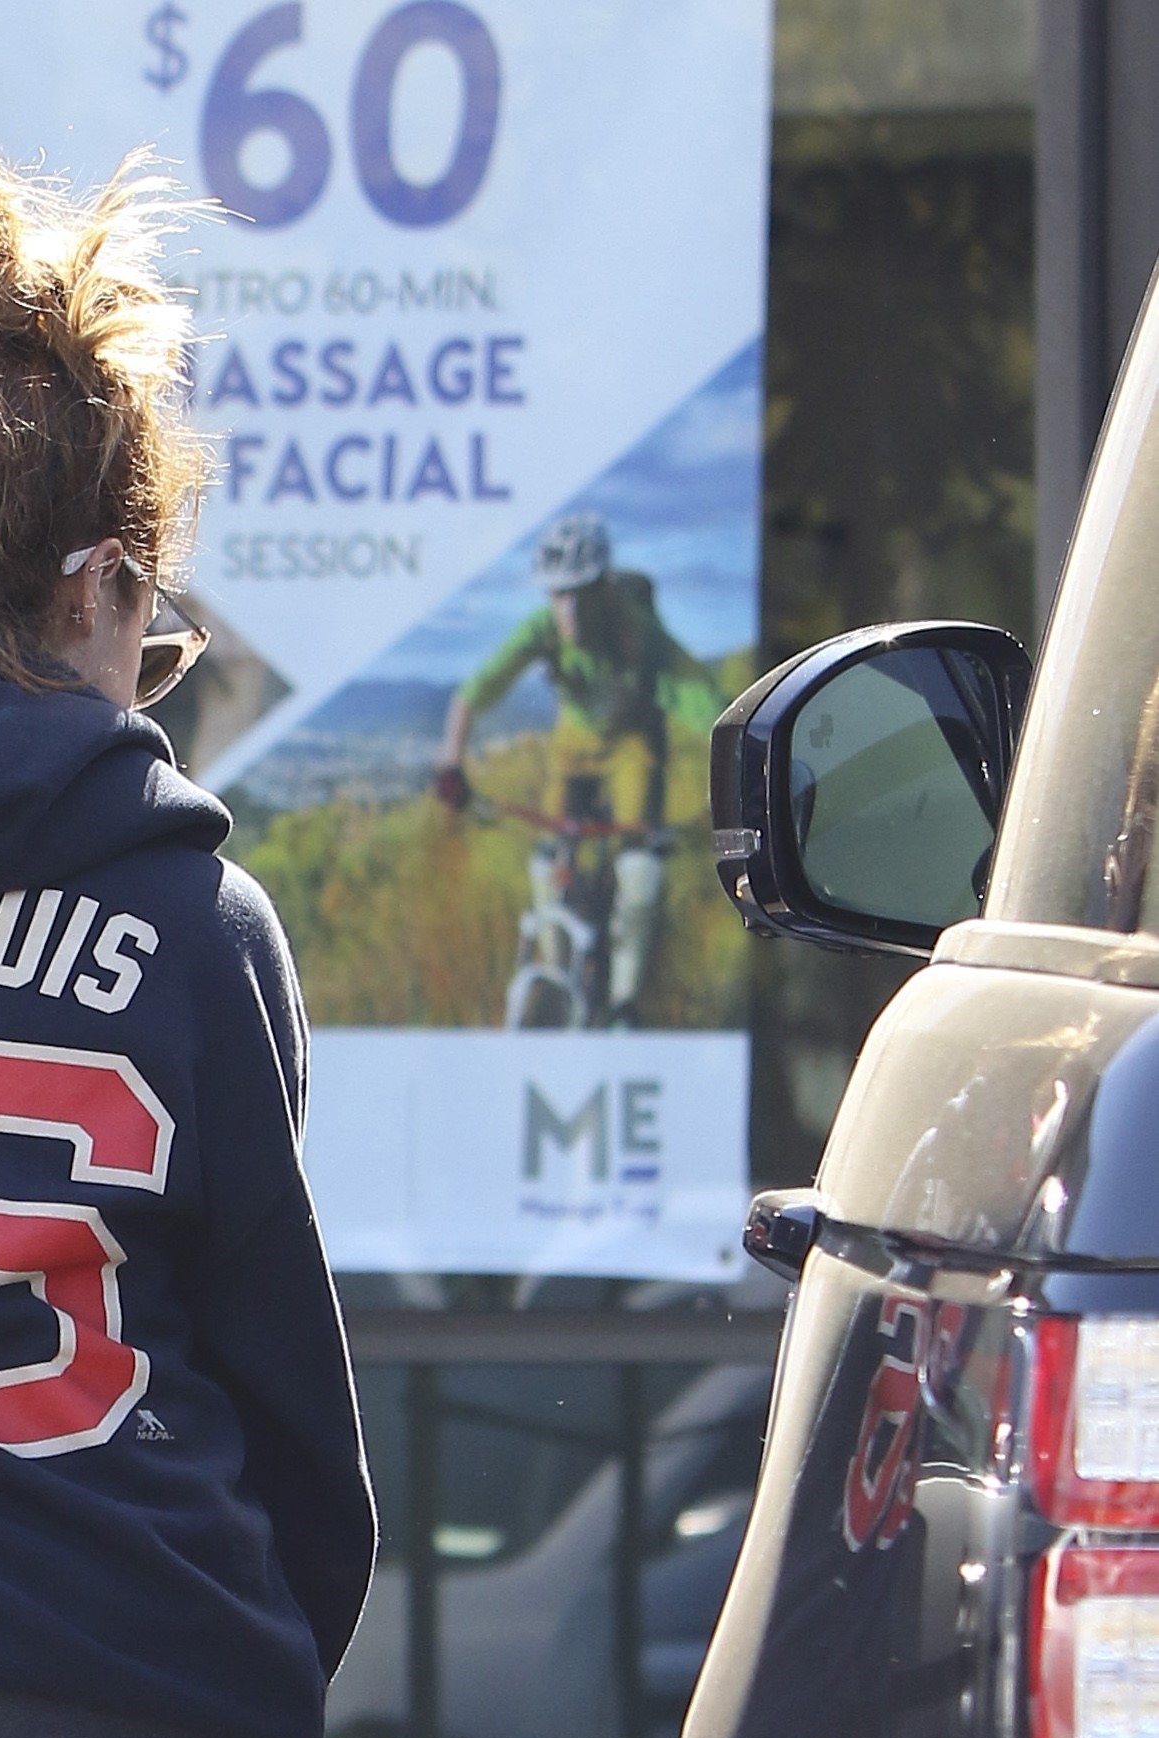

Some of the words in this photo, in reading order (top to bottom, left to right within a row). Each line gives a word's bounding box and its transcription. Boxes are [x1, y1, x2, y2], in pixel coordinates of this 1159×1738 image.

[182, 336, 527, 408] ASSAGE
[228, 433, 511, 501] FACIAL
[221, 534, 422, 580] SESSION
[523, 1076, 663, 1182] ME
